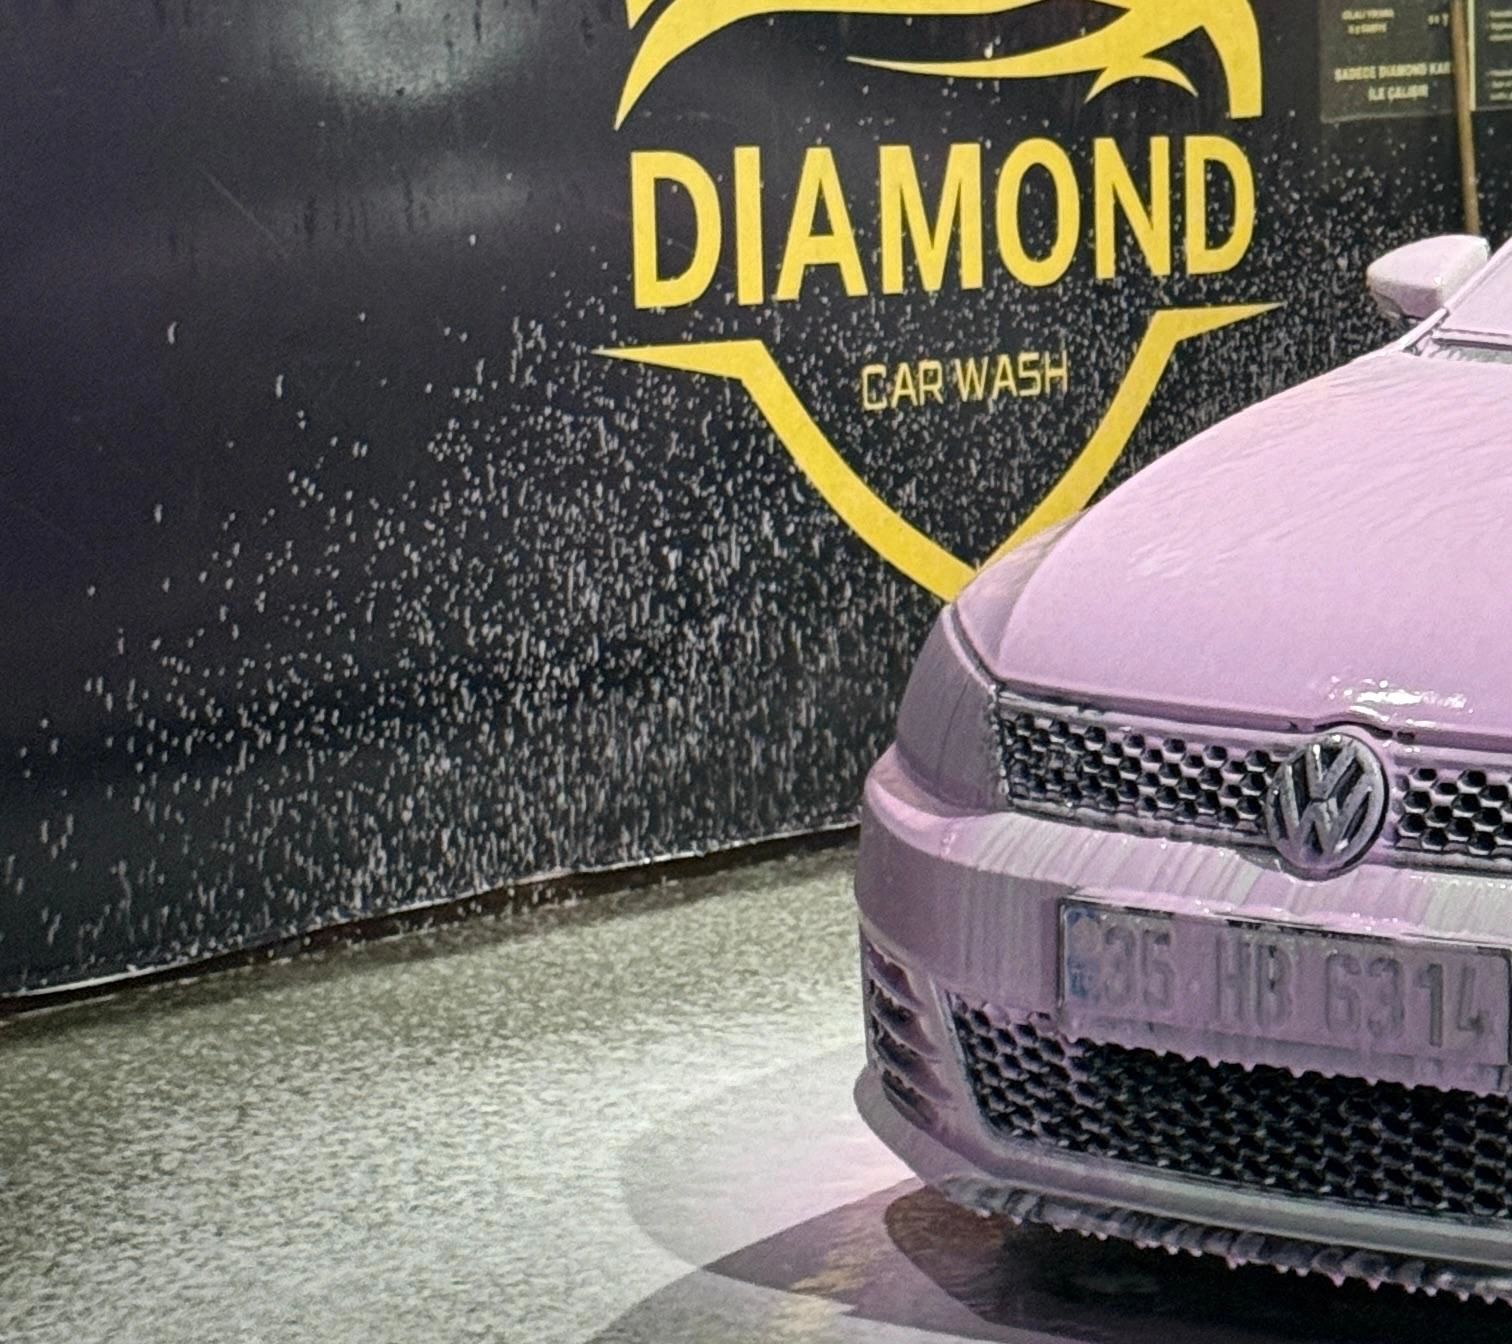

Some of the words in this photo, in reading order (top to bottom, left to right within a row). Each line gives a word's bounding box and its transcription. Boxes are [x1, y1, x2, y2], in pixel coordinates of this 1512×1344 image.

[1378, 63, 1428, 79] DIAMOND
[631, 134, 1256, 310] DIAMOND
[861, 359, 944, 411] CAR
[953, 349, 1069, 402] WASH
[1325, 951, 1494, 1047] 6314
